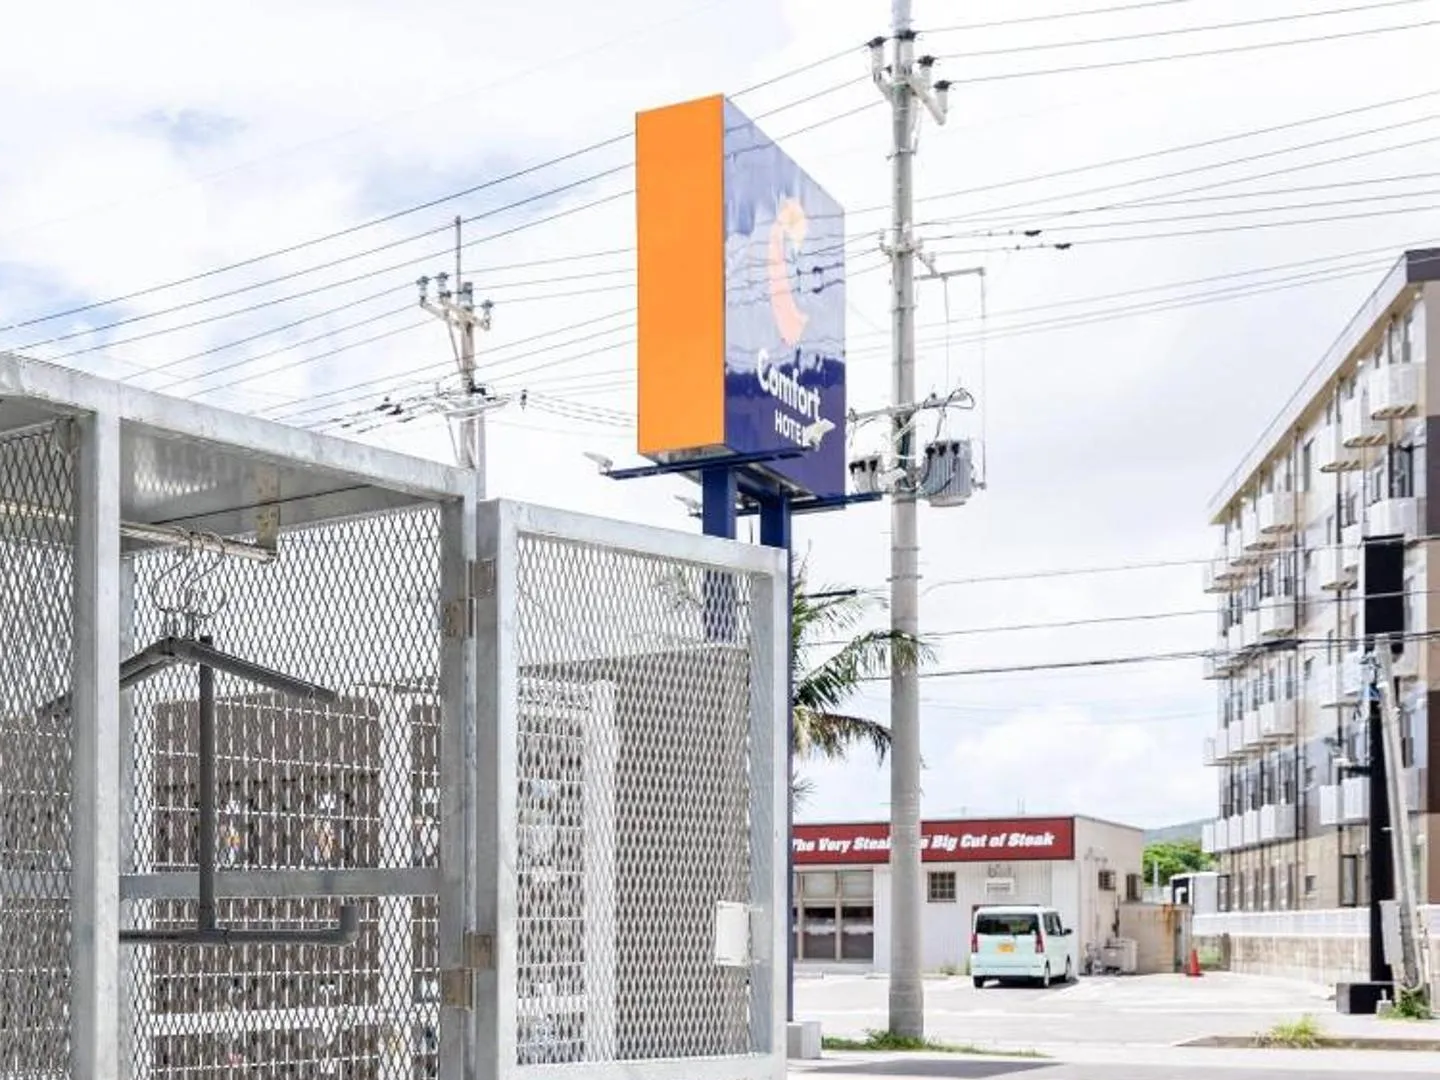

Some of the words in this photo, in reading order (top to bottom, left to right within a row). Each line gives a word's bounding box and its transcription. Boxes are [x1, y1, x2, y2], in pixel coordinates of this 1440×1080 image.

[758, 348, 820, 422] Comfort
[774, 408, 812, 447] HOTEL
[793, 838, 815, 850] The
[818, 837, 851, 853] Very
[931, 835, 958, 851] Big
[960, 833, 987, 848] Cut
[989, 832, 1007, 847] of
[1008, 831, 1055, 846] Steak
